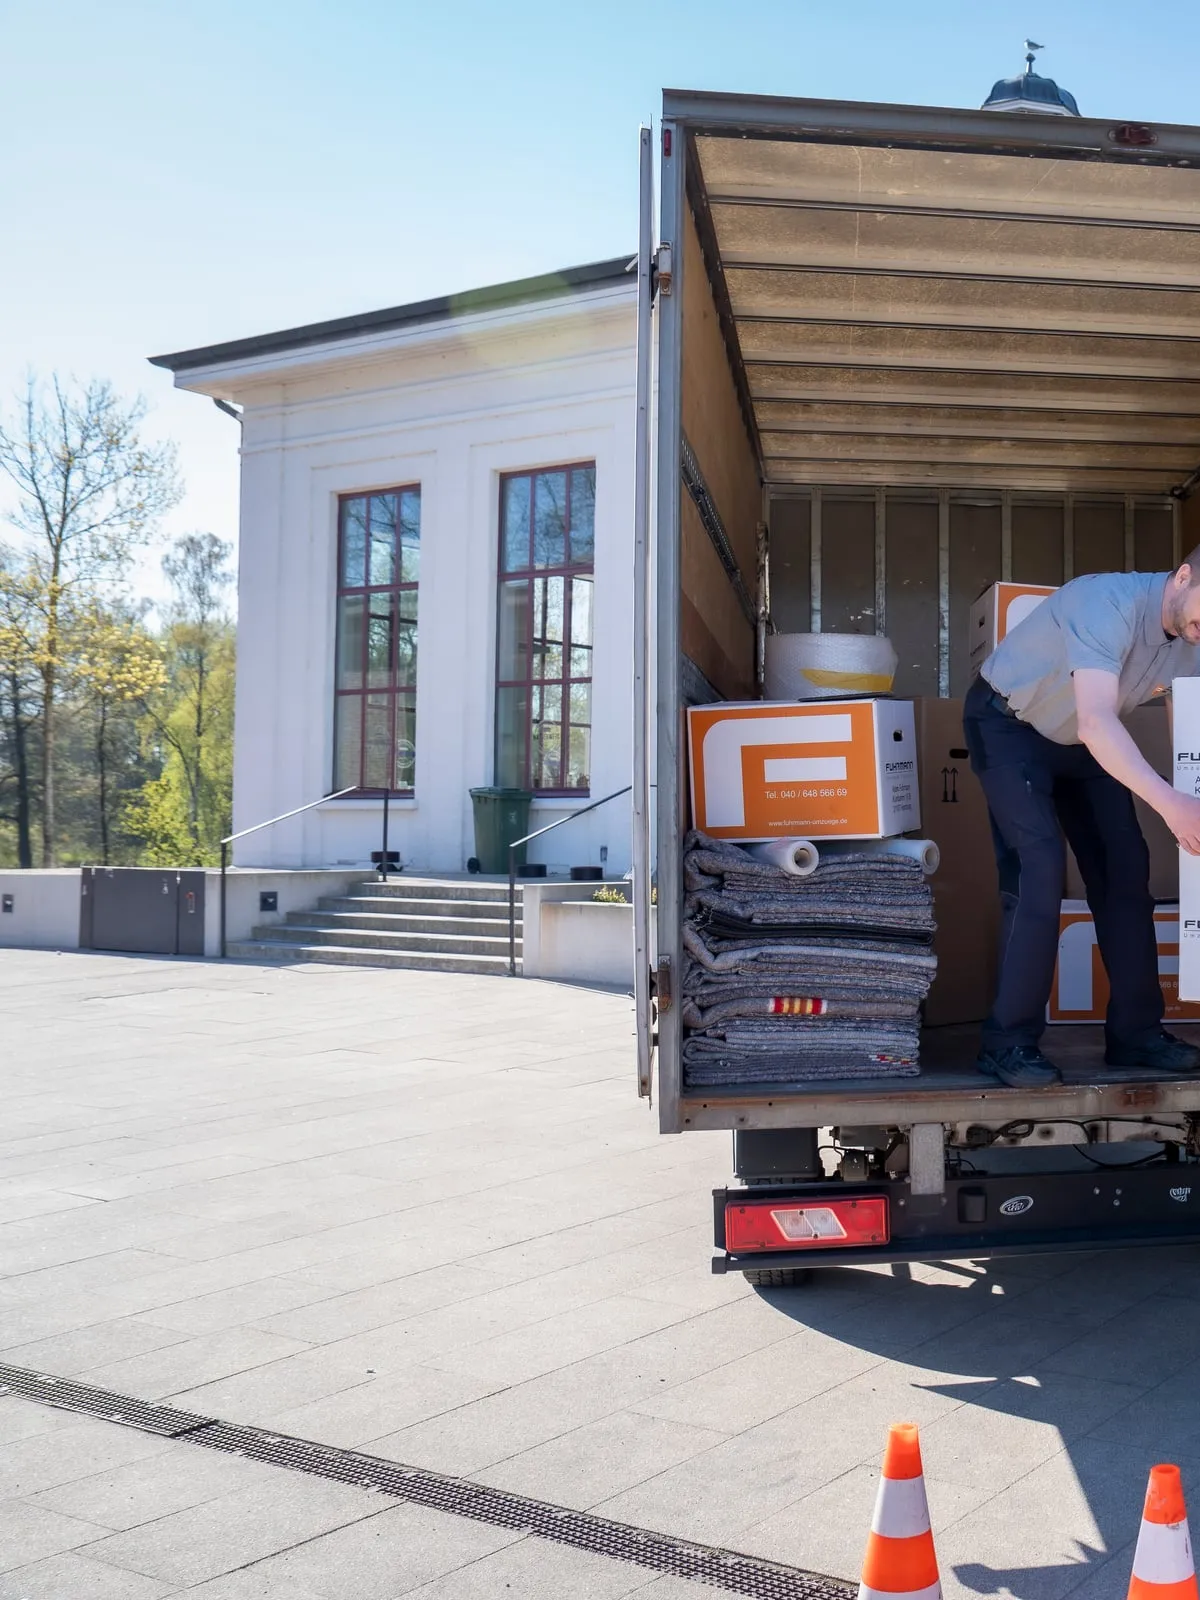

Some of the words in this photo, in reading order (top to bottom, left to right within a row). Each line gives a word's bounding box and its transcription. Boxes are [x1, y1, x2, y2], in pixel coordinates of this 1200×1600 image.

[765, 791, 778, 799] Tel.
[781, 790, 796, 799] 040
[803, 789, 818, 798] 648
[837, 788, 848, 796] 69
